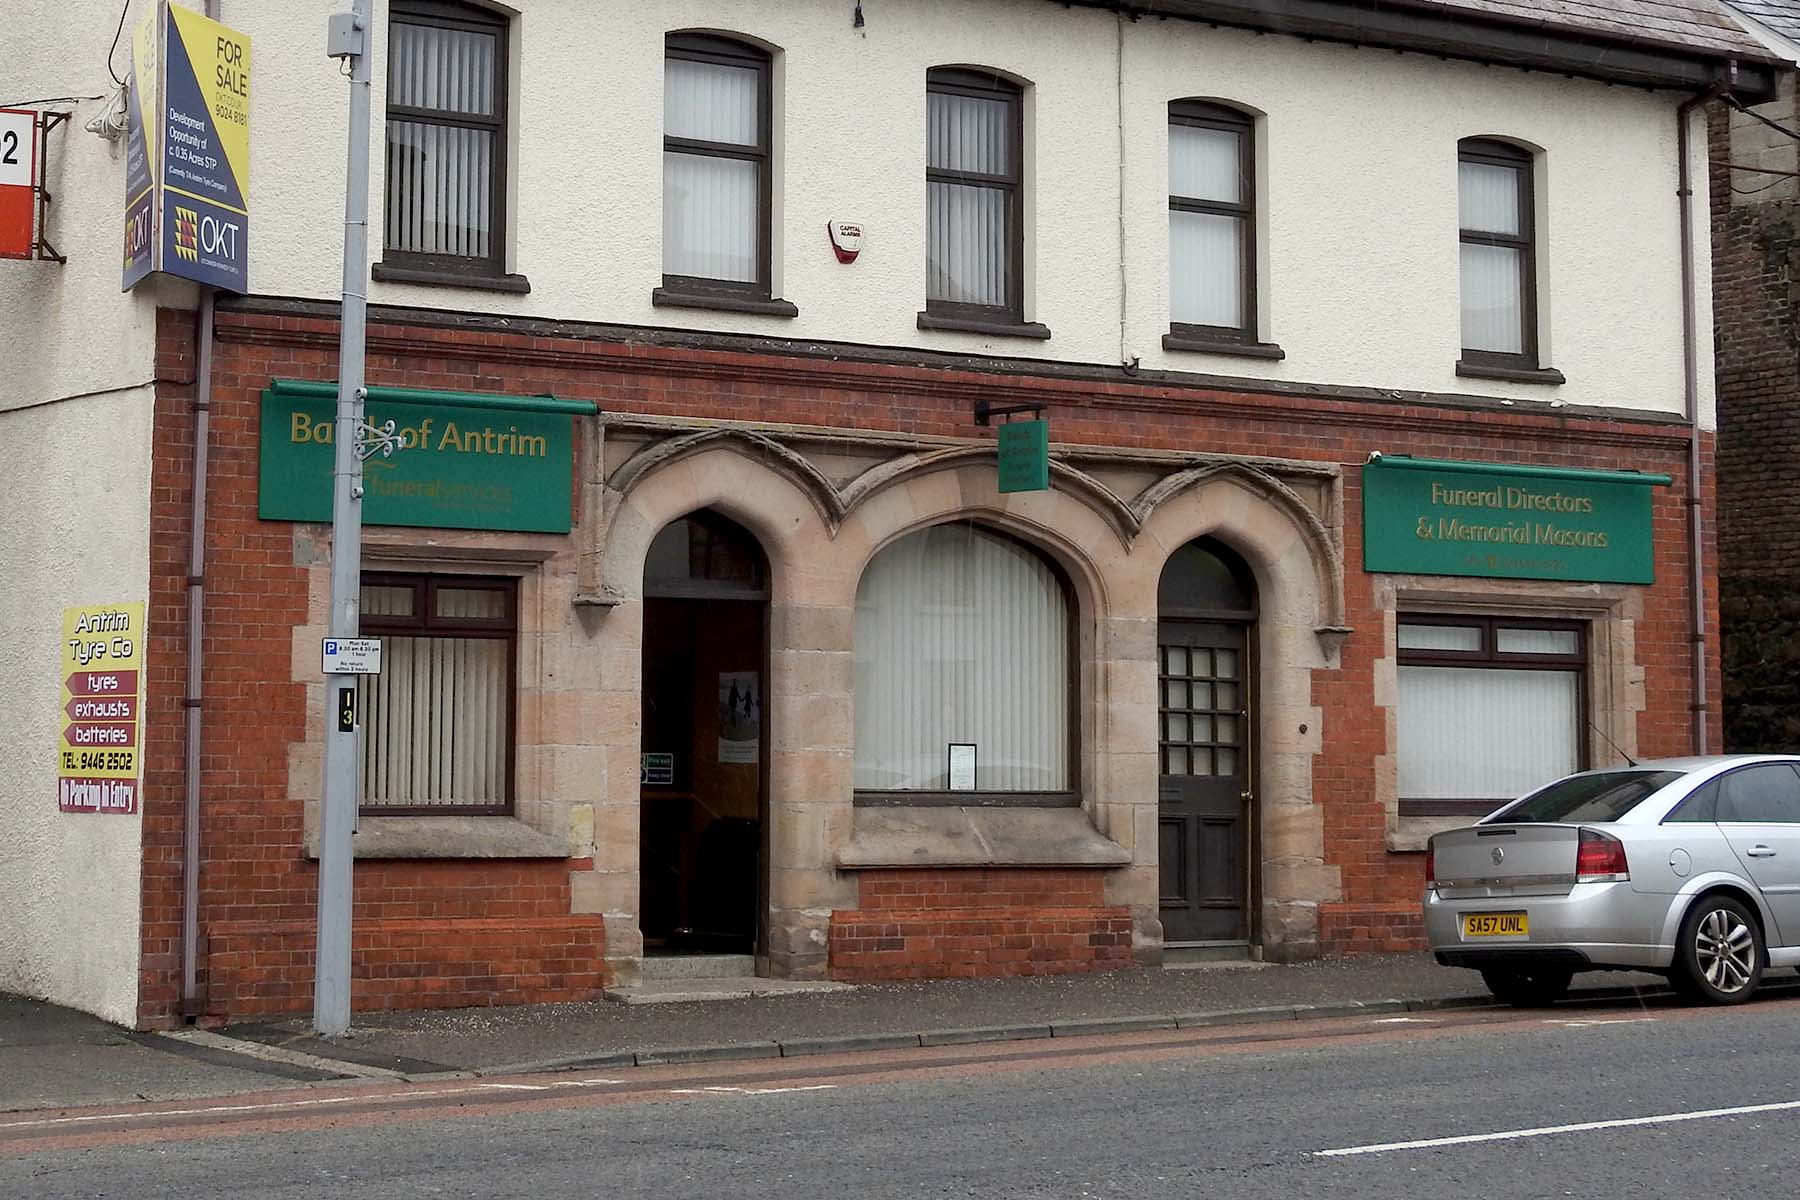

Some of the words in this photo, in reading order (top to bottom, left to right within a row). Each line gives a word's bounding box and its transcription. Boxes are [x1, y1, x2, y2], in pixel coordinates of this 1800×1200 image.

[217, 36, 242, 68] FOR
[216, 64, 248, 98] SALE
[169, 107, 206, 132] Development
[216, 103, 233, 120] 9024
[0, 130, 18, 165] 2
[169, 125, 201, 150] Opportunity
[188, 151, 204, 167] Acres
[205, 156, 217, 170] STP
[133, 205, 149, 251] OKT
[201, 215, 239, 260] OKT
[290, 412, 387, 446] Bak
[400, 417, 433, 449] of
[438, 422, 547, 457] Antrim
[1431, 481, 1502, 509] Funeral
[1507, 487, 1593, 513] Directors
[1416, 516, 1432, 540] &
[1438, 518, 1530, 545] Memorial
[1535, 524, 1608, 548] Masons
[75, 610, 130, 634] Antrim
[69, 639, 106, 665] Tyre
[110, 637, 133, 659] Co
[87, 673, 118, 692] tyres
[75, 700, 130, 718] exhausts
[76, 726, 128, 744] batteries
[62, 752, 79, 769] TEL:
[81, 752, 105, 770] 9446
[107, 752, 133, 770] 2502
[70, 779, 101, 811] Parking
[110, 781, 134, 813] Entry
[1469, 917, 1498, 934] SA57
[1500, 916, 1523, 933] UNL
